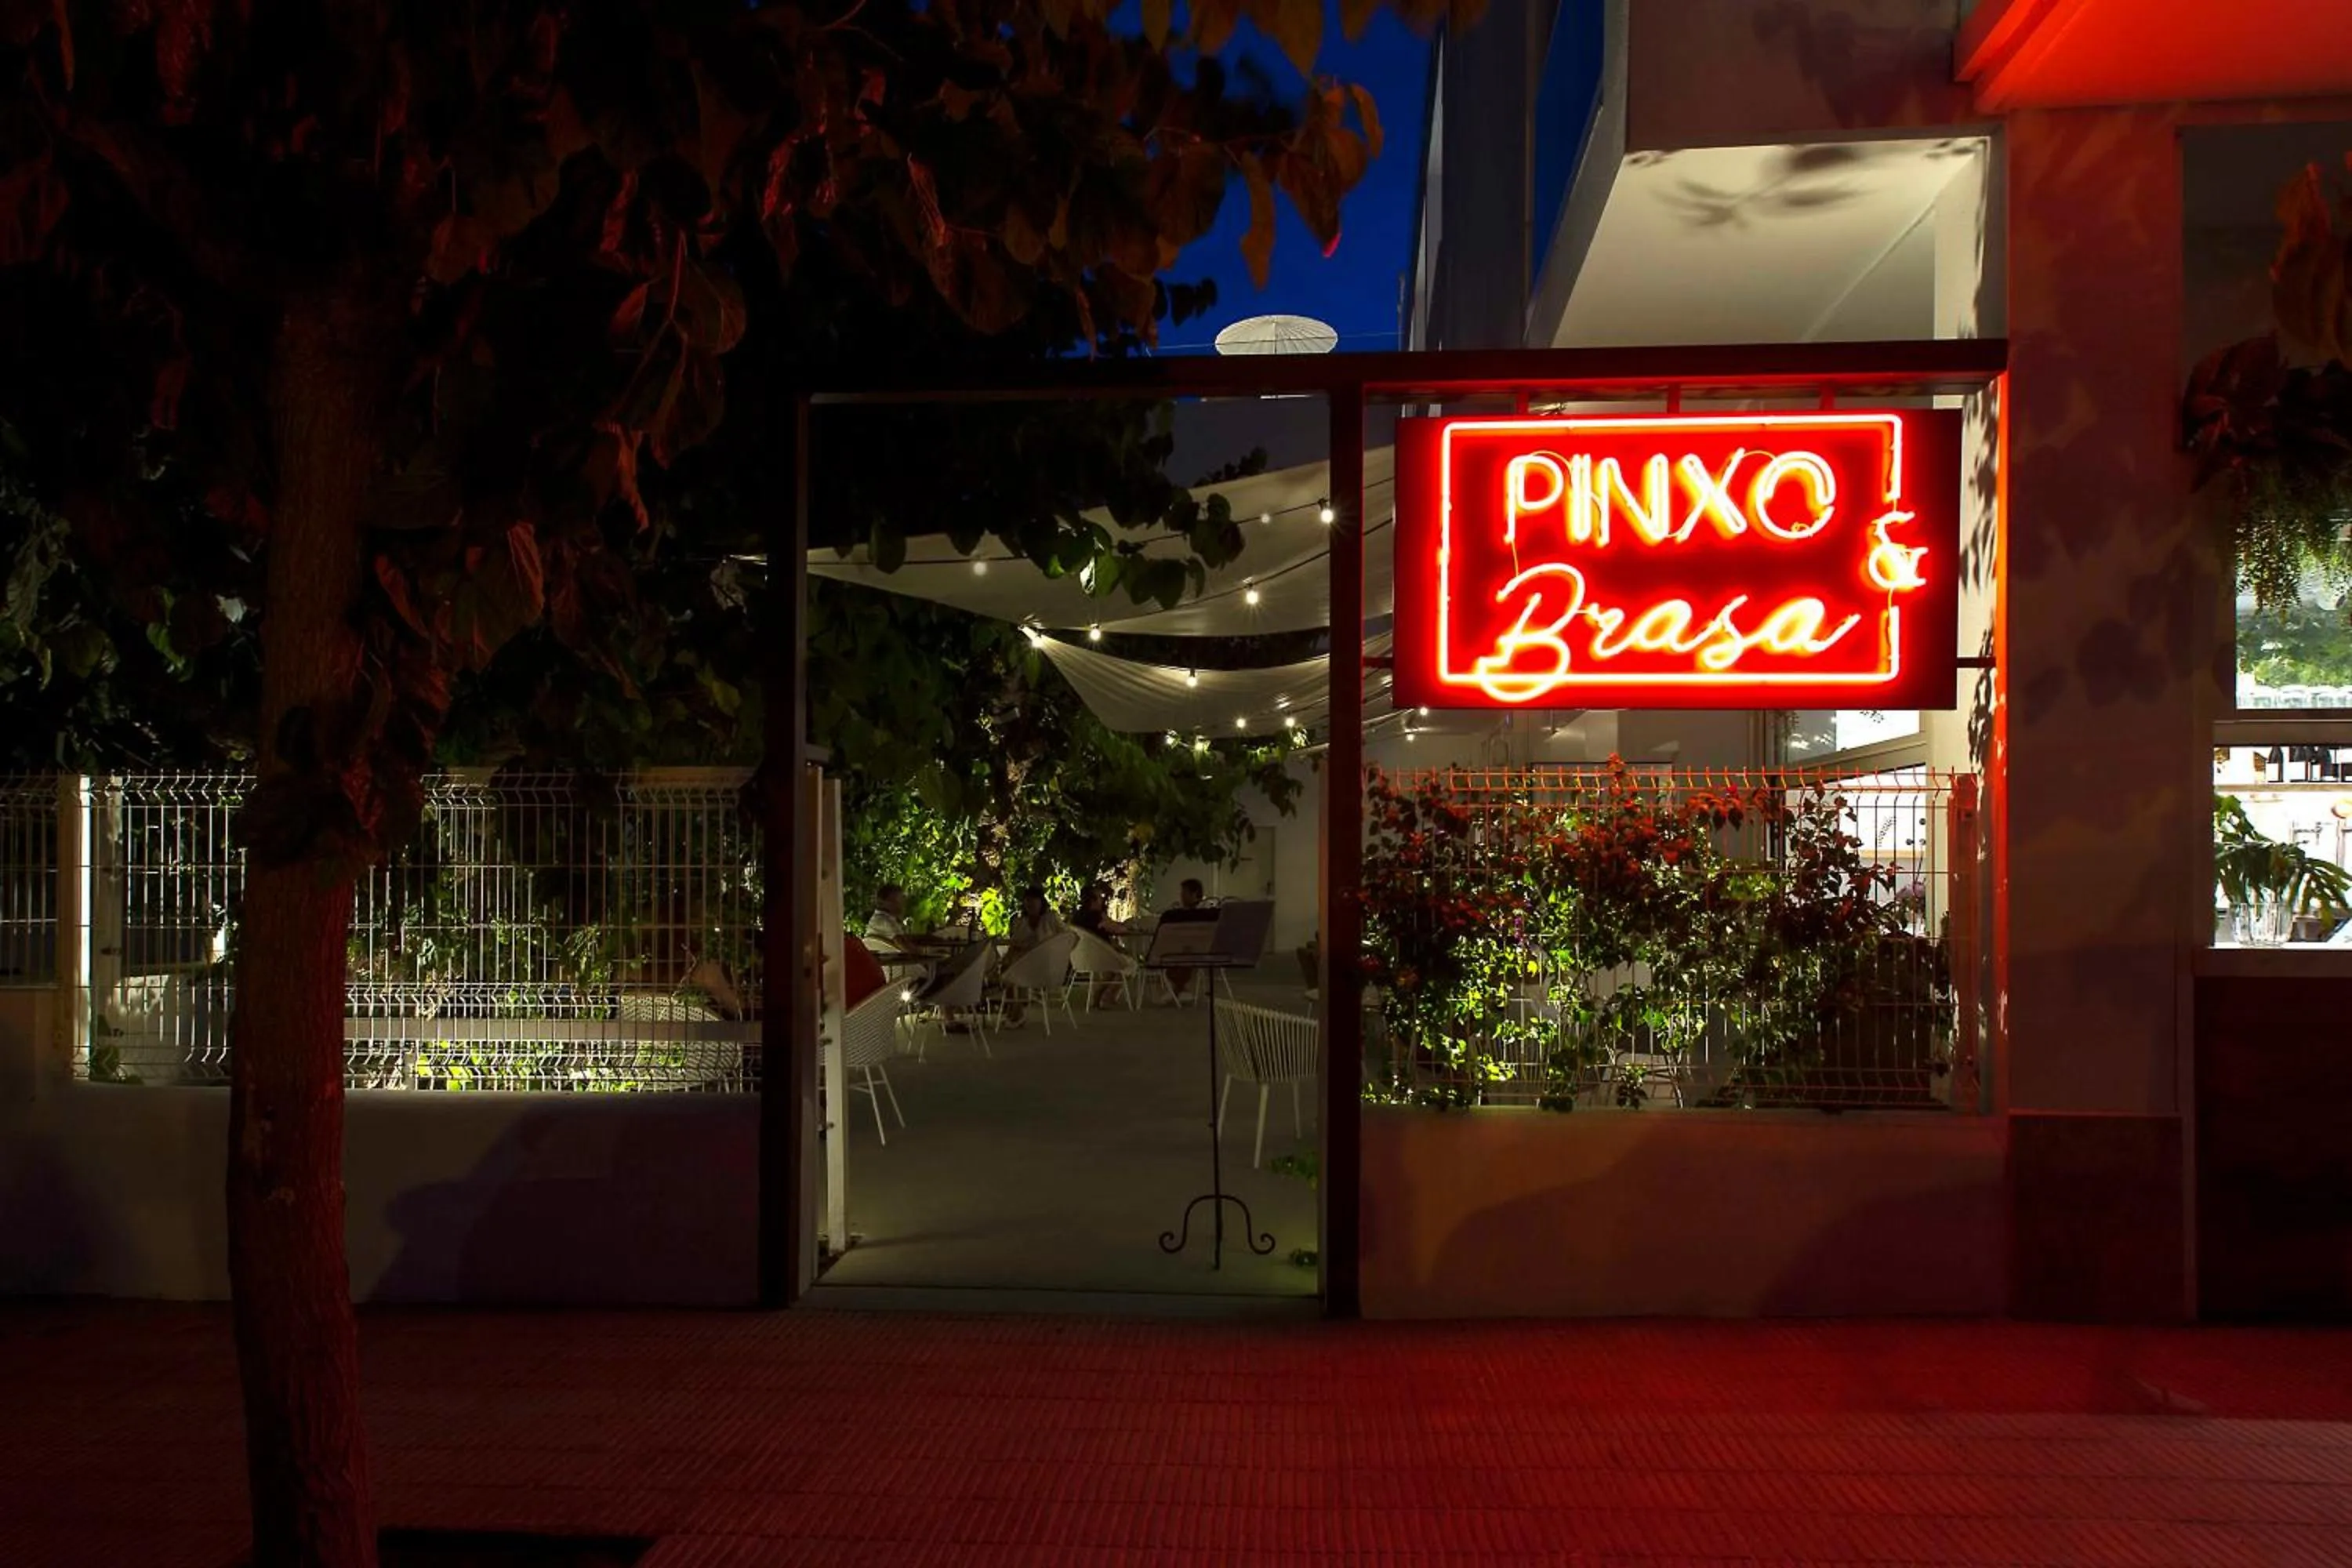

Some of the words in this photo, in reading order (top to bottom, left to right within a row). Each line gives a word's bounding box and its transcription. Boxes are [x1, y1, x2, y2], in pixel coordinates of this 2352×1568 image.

[1505, 449, 1837, 546] PINXO
[1866, 510, 1930, 590] &
[1477, 562, 1862, 702] Brasa
